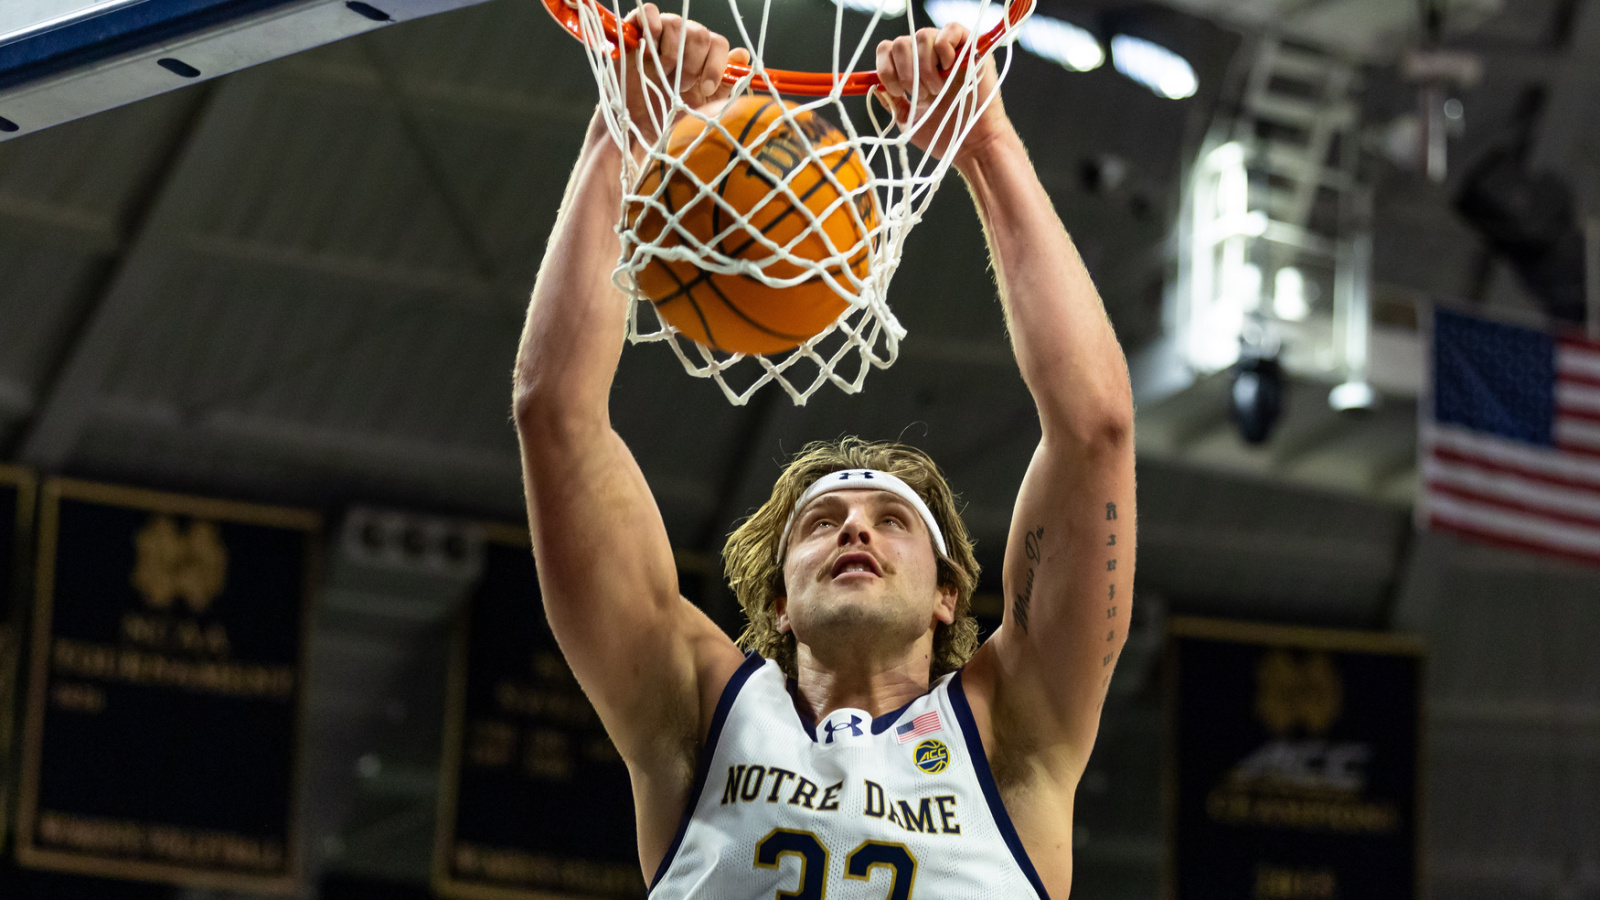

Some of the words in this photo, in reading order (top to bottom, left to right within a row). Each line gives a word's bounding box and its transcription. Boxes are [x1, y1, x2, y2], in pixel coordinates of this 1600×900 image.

[919, 746, 947, 763] ACC
[721, 764, 844, 811] NOTRE
[863, 778, 961, 836] DAME
